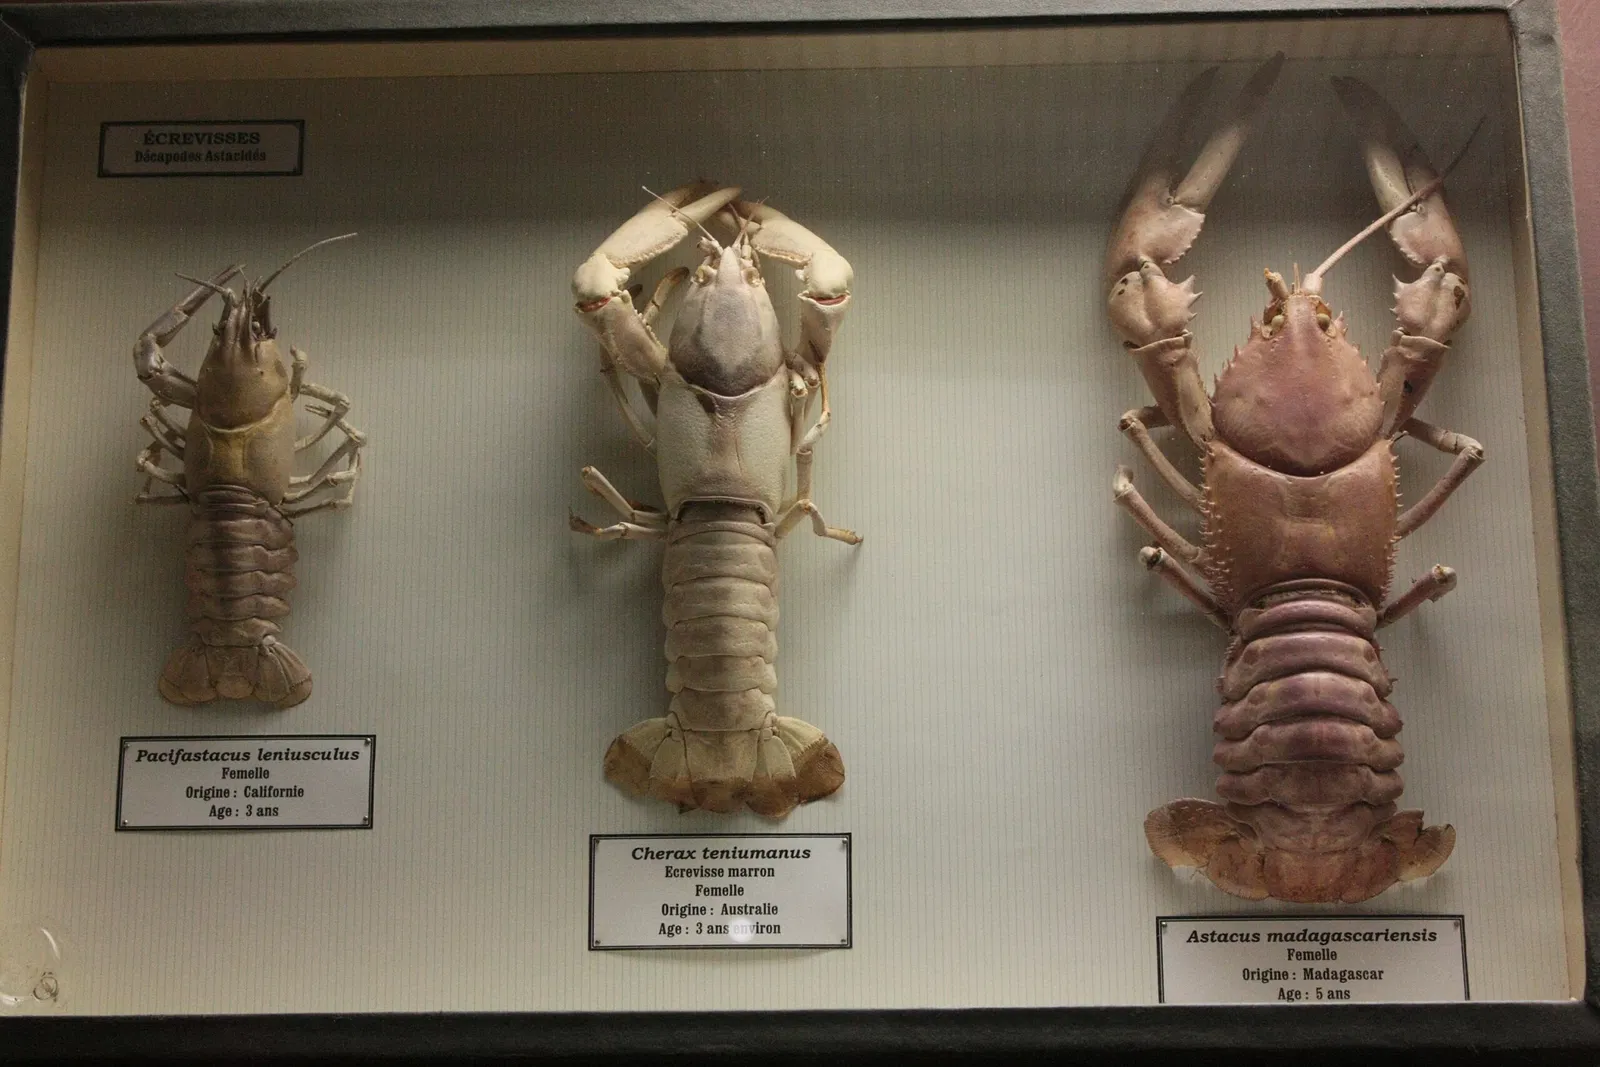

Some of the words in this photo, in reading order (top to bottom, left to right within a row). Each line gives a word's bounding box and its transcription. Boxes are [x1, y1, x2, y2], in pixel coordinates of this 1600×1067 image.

[143, 129, 261, 145] ÉCREVISSES
[135, 749, 251, 765] Pacifastacus
[257, 748, 360, 761] leniusculus
[221, 767, 270, 779] Femelle
[243, 786, 305, 798] Californie
[245, 805, 252, 817] 3
[256, 807, 279, 817] ans
[631, 847, 697, 860] Cherax
[702, 847, 812, 859] teniumanus
[664, 865, 725, 878] Ecrevisse
[727, 867, 775, 877] marron
[695, 884, 744, 896] Femelle
[720, 903, 779, 915] Australie
[695, 922, 703, 935] 3
[707, 925, 730, 935] ans
[1186, 930, 1261, 943] Astacus
[1267, 928, 1438, 944] madagascariensis
[1287, 948, 1338, 961] Femelle
[1303, 967, 1384, 983] Madagascar
[1316, 987, 1324, 1000] 5
[1327, 989, 1351, 1000] ans
